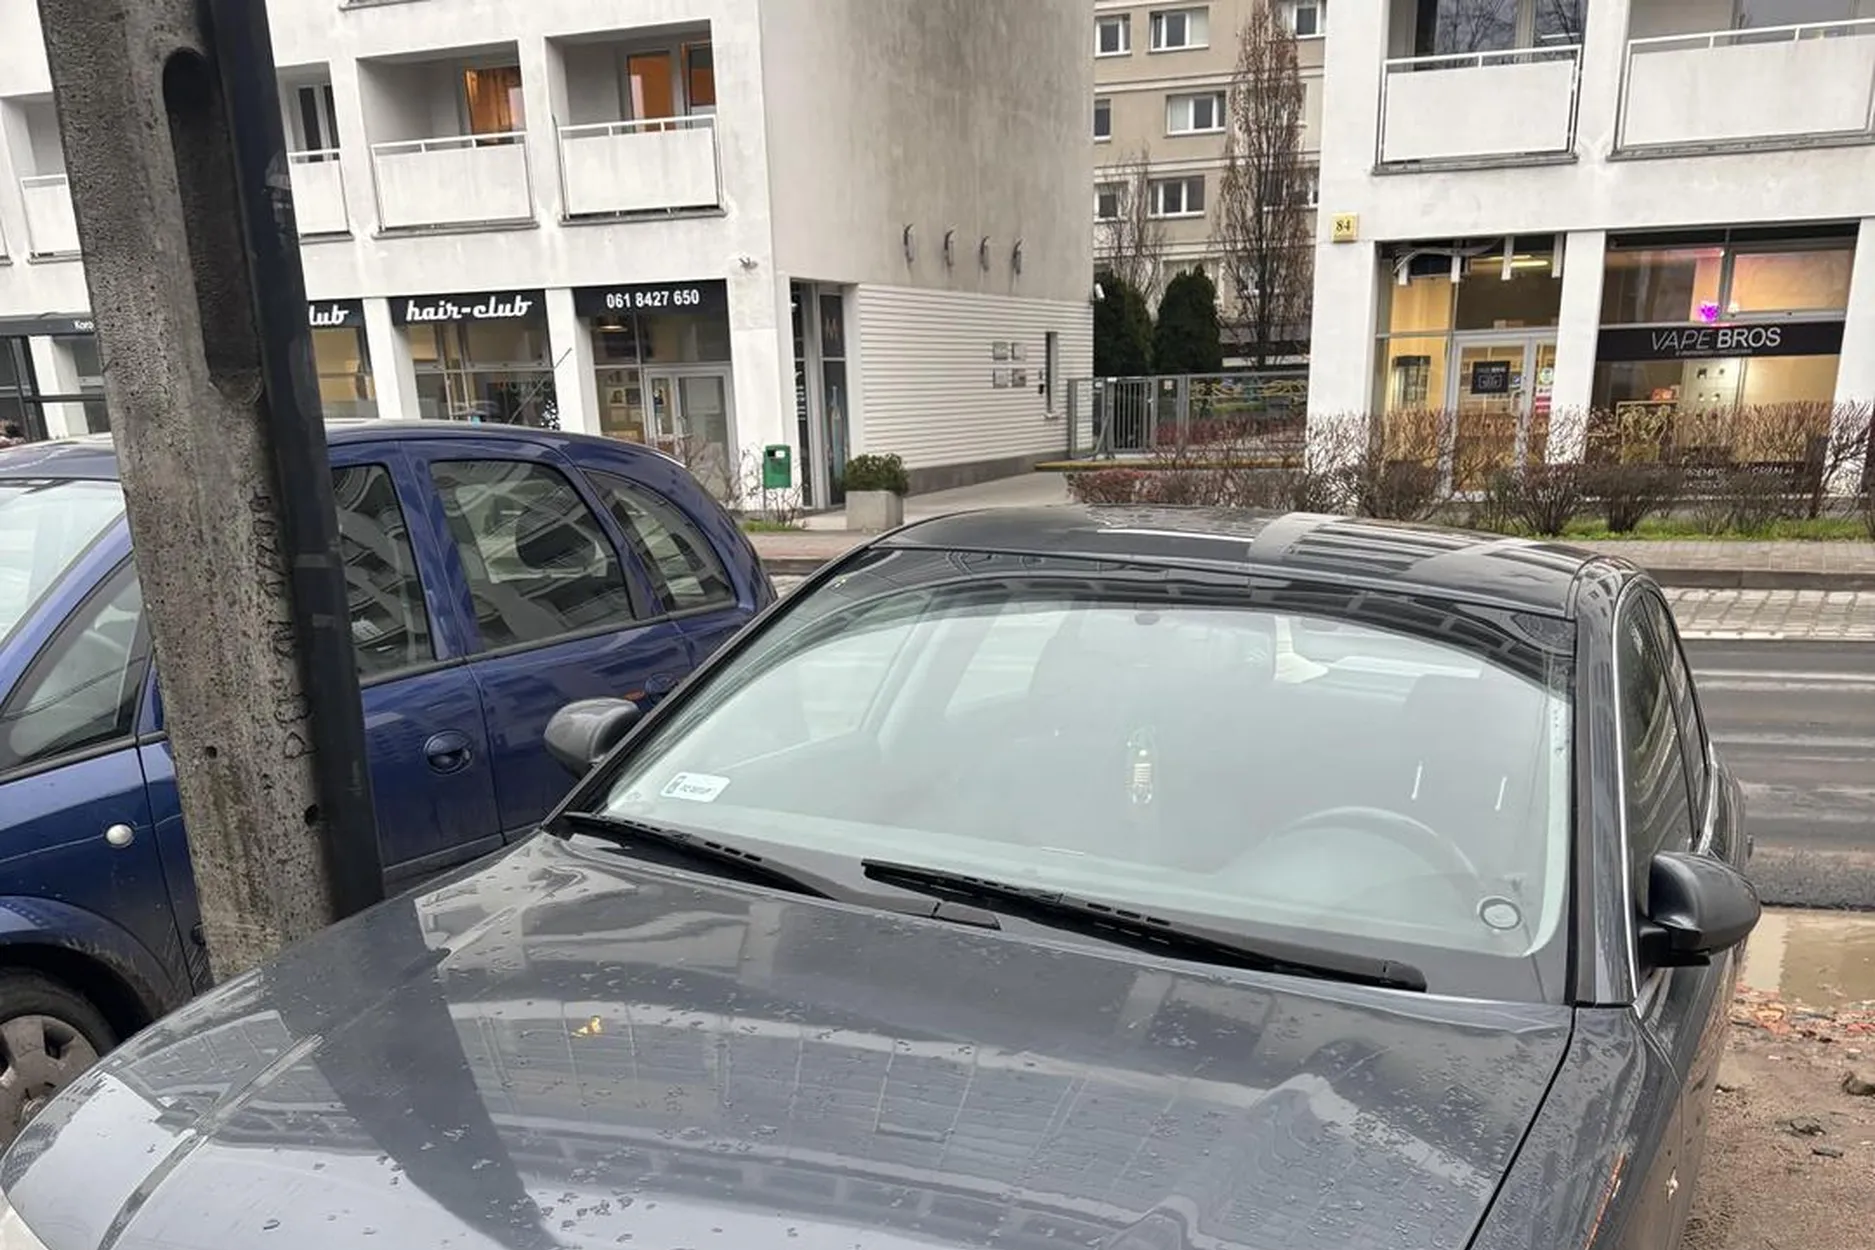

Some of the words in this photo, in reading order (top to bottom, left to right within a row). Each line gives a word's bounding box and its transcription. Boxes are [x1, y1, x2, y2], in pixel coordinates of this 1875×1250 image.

[1336, 219, 1351, 232] 84
[406, 295, 532, 321] hair-club
[606, 293, 631, 309] 061
[635, 291, 669, 308] 8427
[673, 289, 700, 305] 650
[1651, 331, 1714, 350] VAPE
[1716, 327, 1781, 348] BROS
